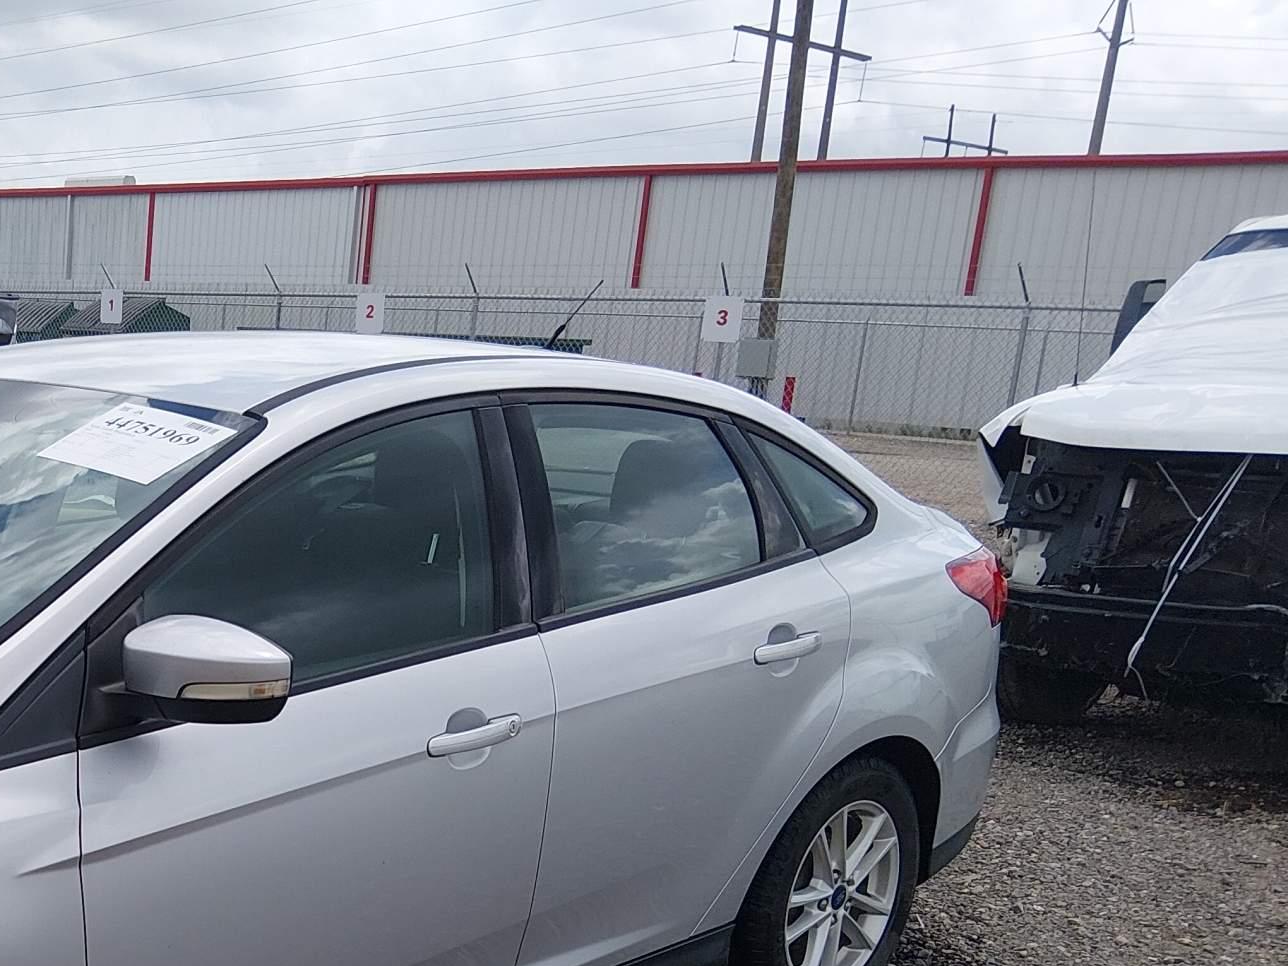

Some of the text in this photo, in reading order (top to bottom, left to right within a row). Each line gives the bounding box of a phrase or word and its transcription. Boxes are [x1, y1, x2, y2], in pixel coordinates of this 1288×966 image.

[108, 299, 114, 312] 1
[365, 304, 375, 319] 2
[716, 309, 729, 326] 3
[105, 416, 200, 446] 44751969
